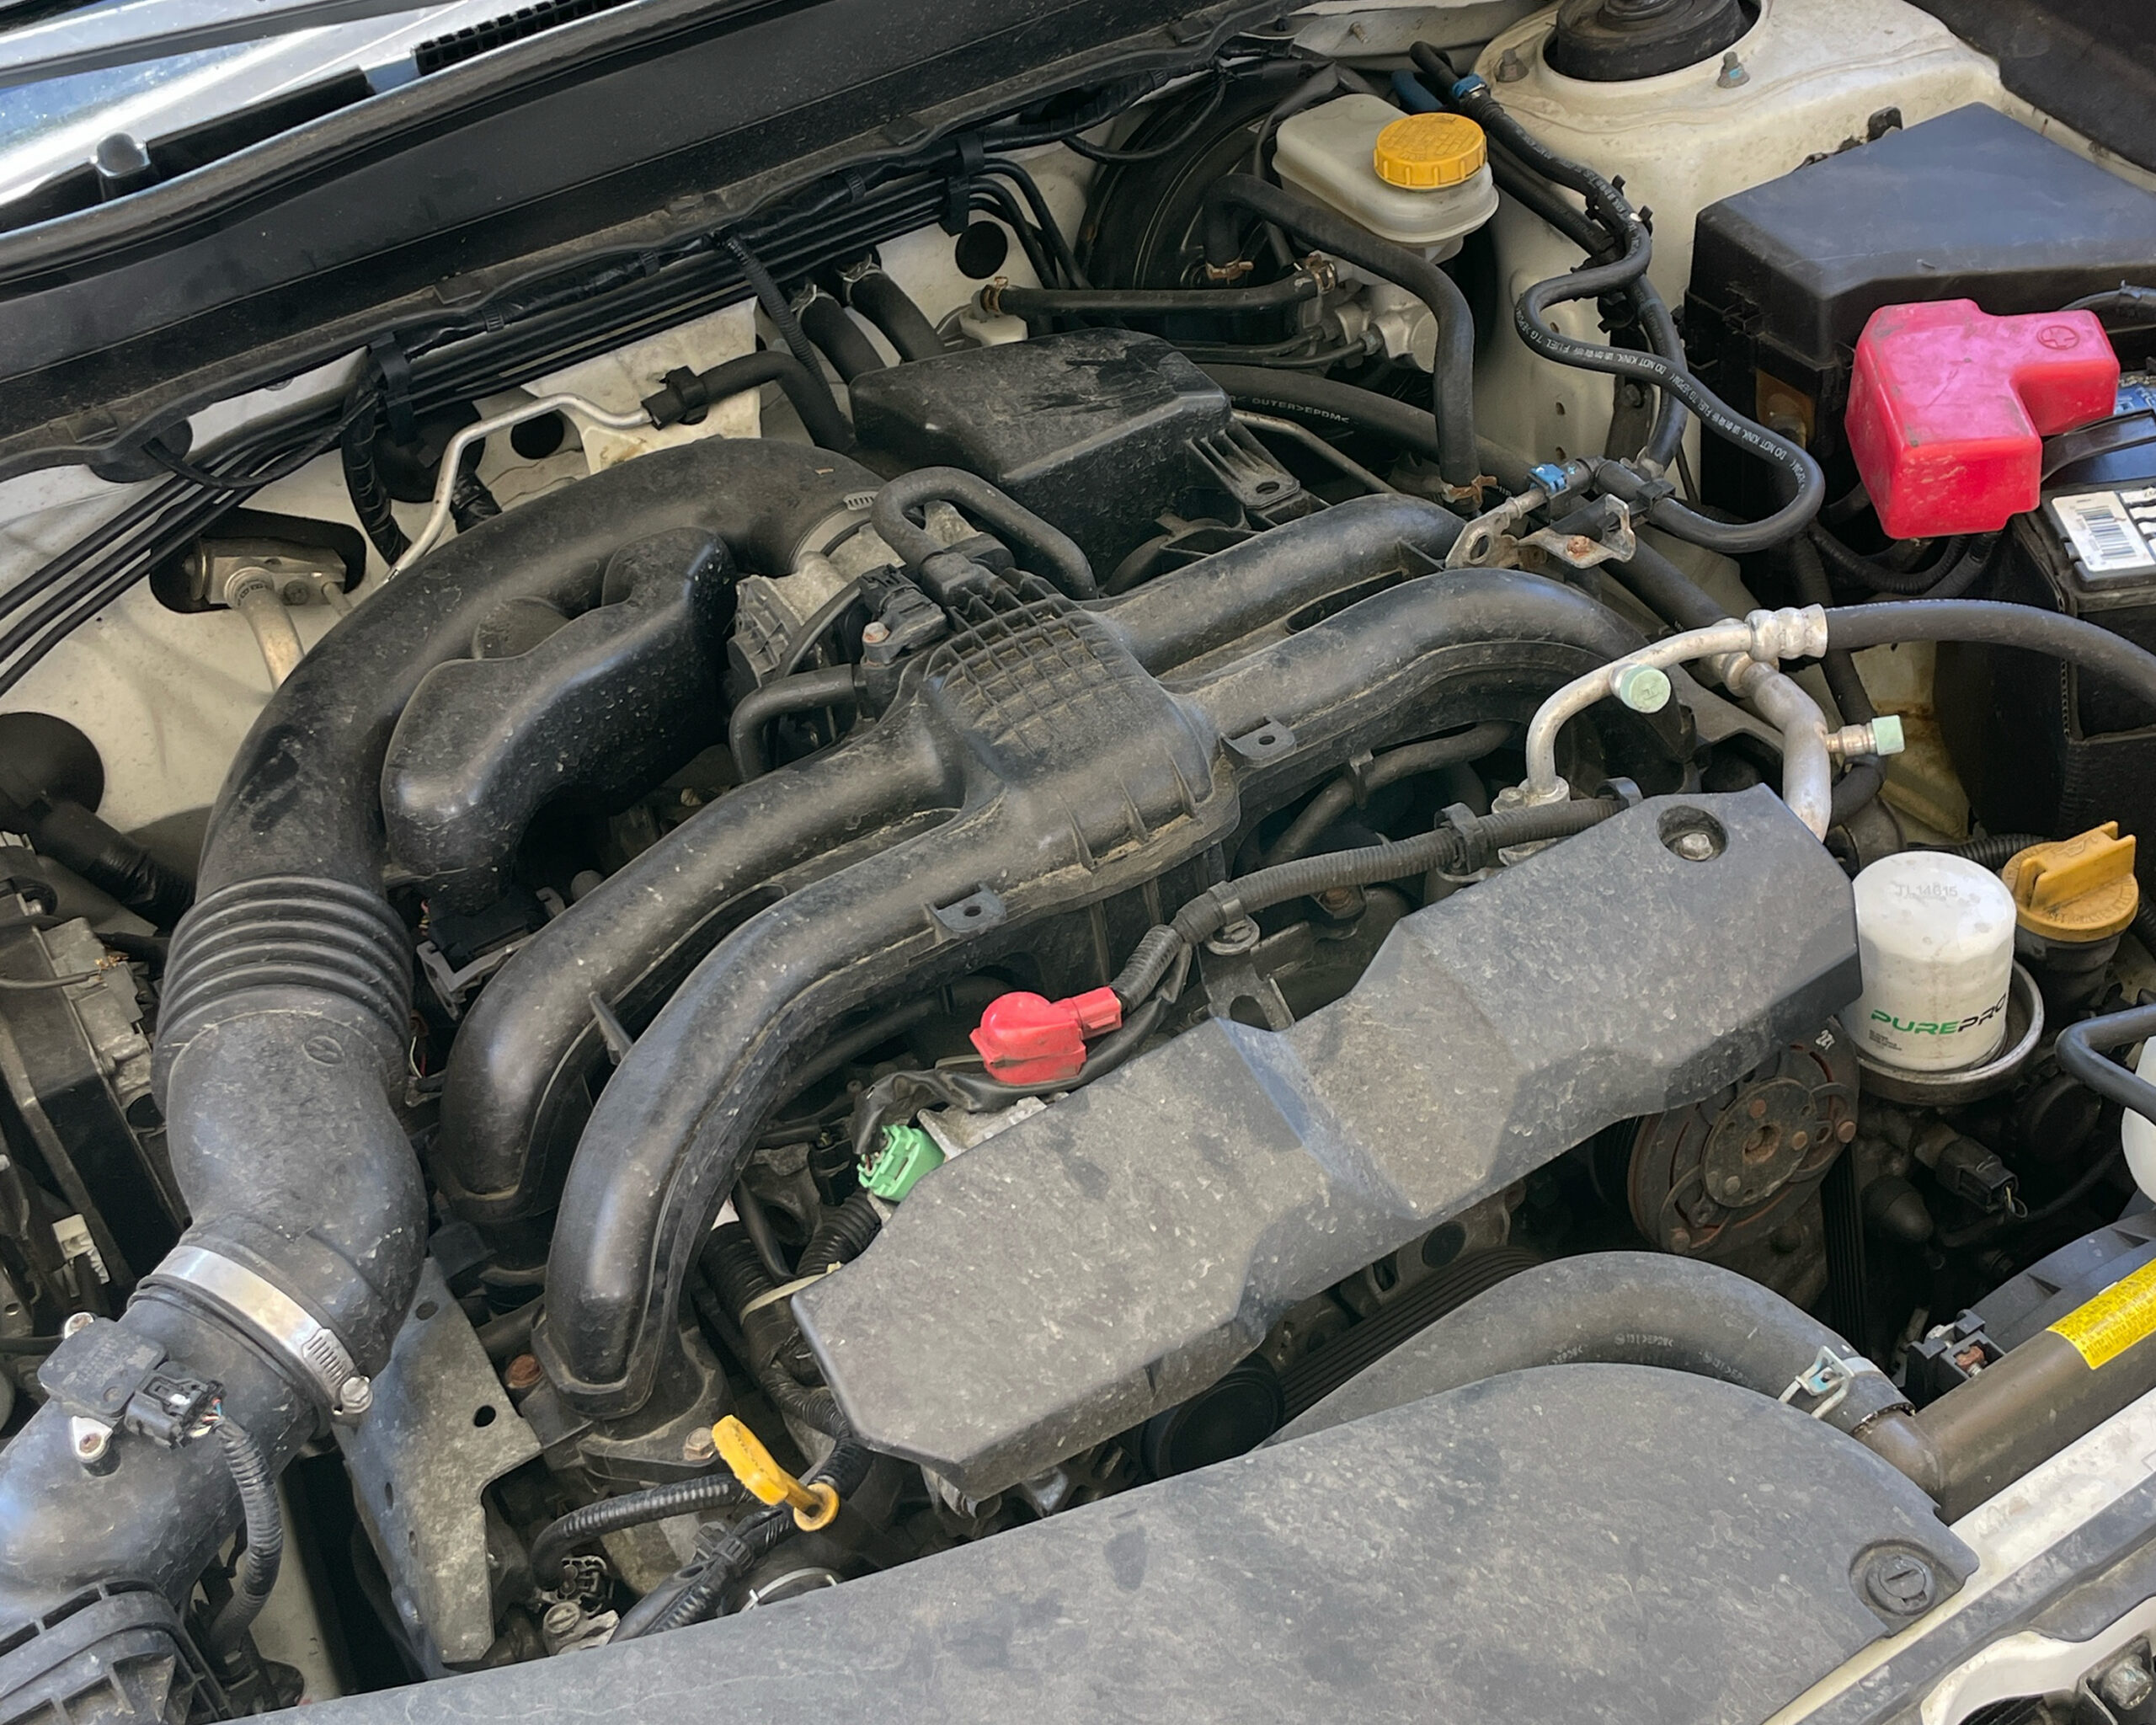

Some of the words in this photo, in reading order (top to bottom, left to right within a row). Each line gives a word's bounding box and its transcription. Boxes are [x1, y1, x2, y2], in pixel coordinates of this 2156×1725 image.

[1546, 338, 1572, 355] FUEL
[1639, 357, 1656, 372] NOT
[1757, 438, 1776, 456] NOT
[1870, 992, 2006, 1035] PUREPRO
